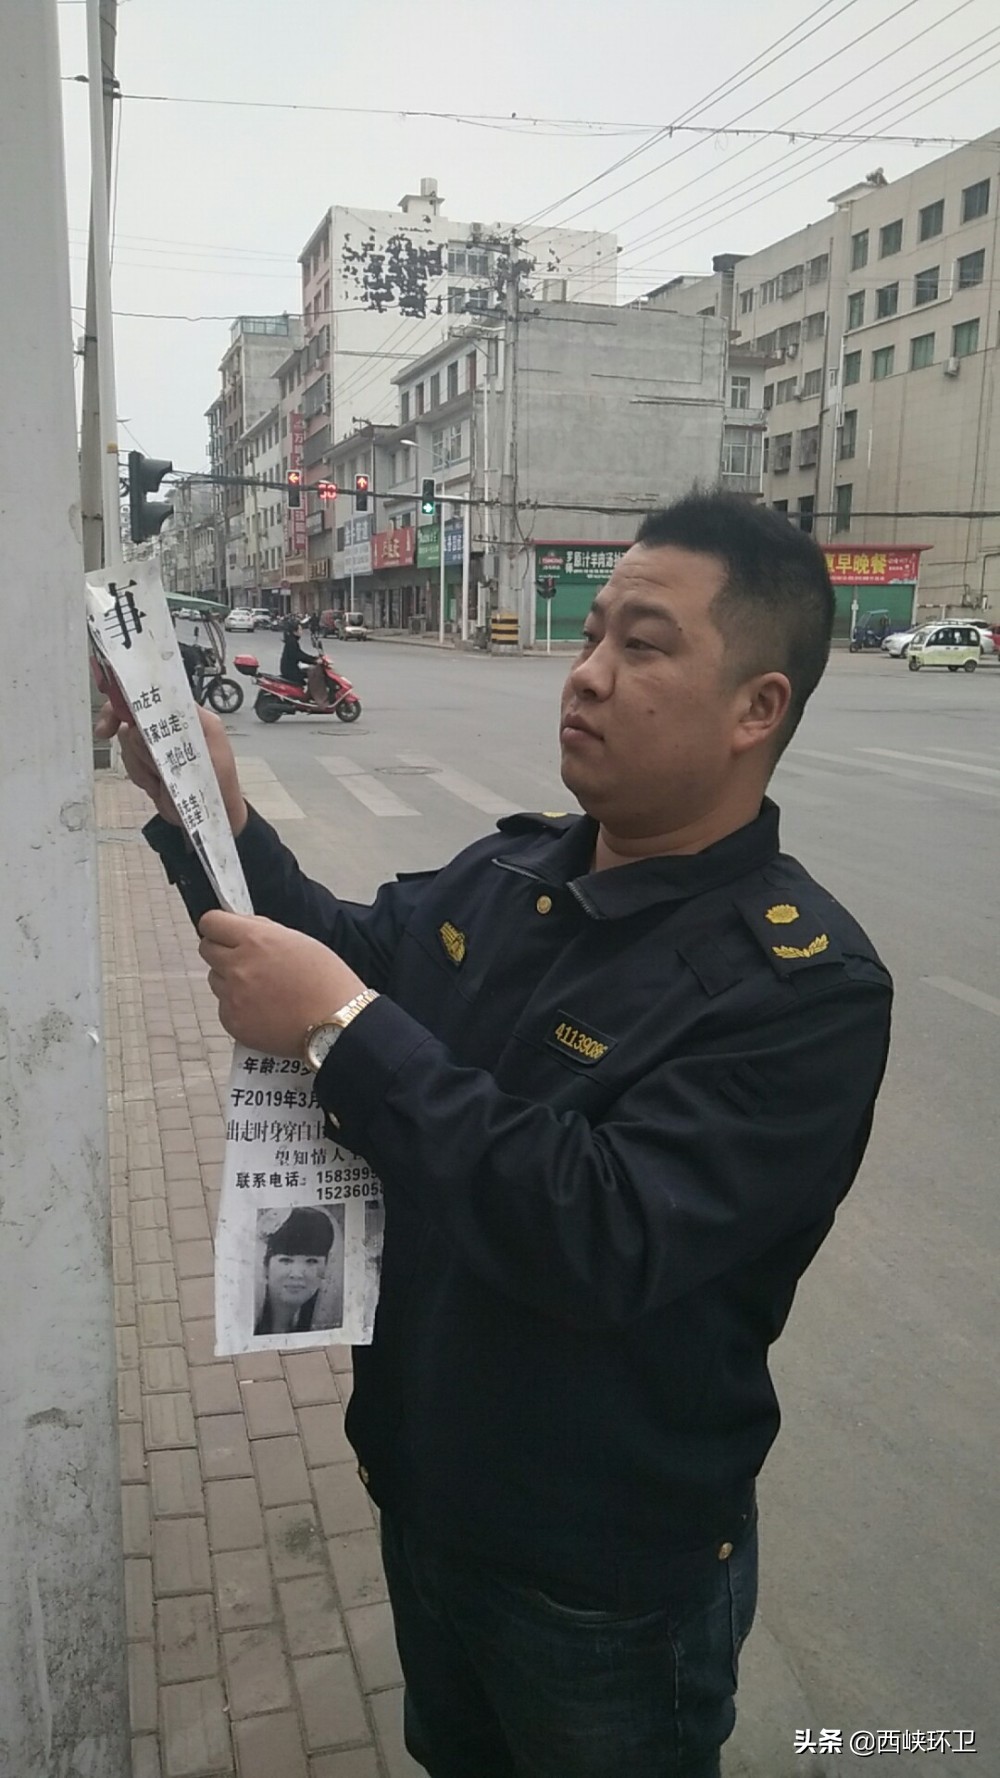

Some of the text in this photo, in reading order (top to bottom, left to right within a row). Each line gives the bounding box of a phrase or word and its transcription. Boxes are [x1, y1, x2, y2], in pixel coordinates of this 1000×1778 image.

[231, 1088, 321, 1109] 于2019年3月
[275, 1148, 362, 1166] 望知情人
